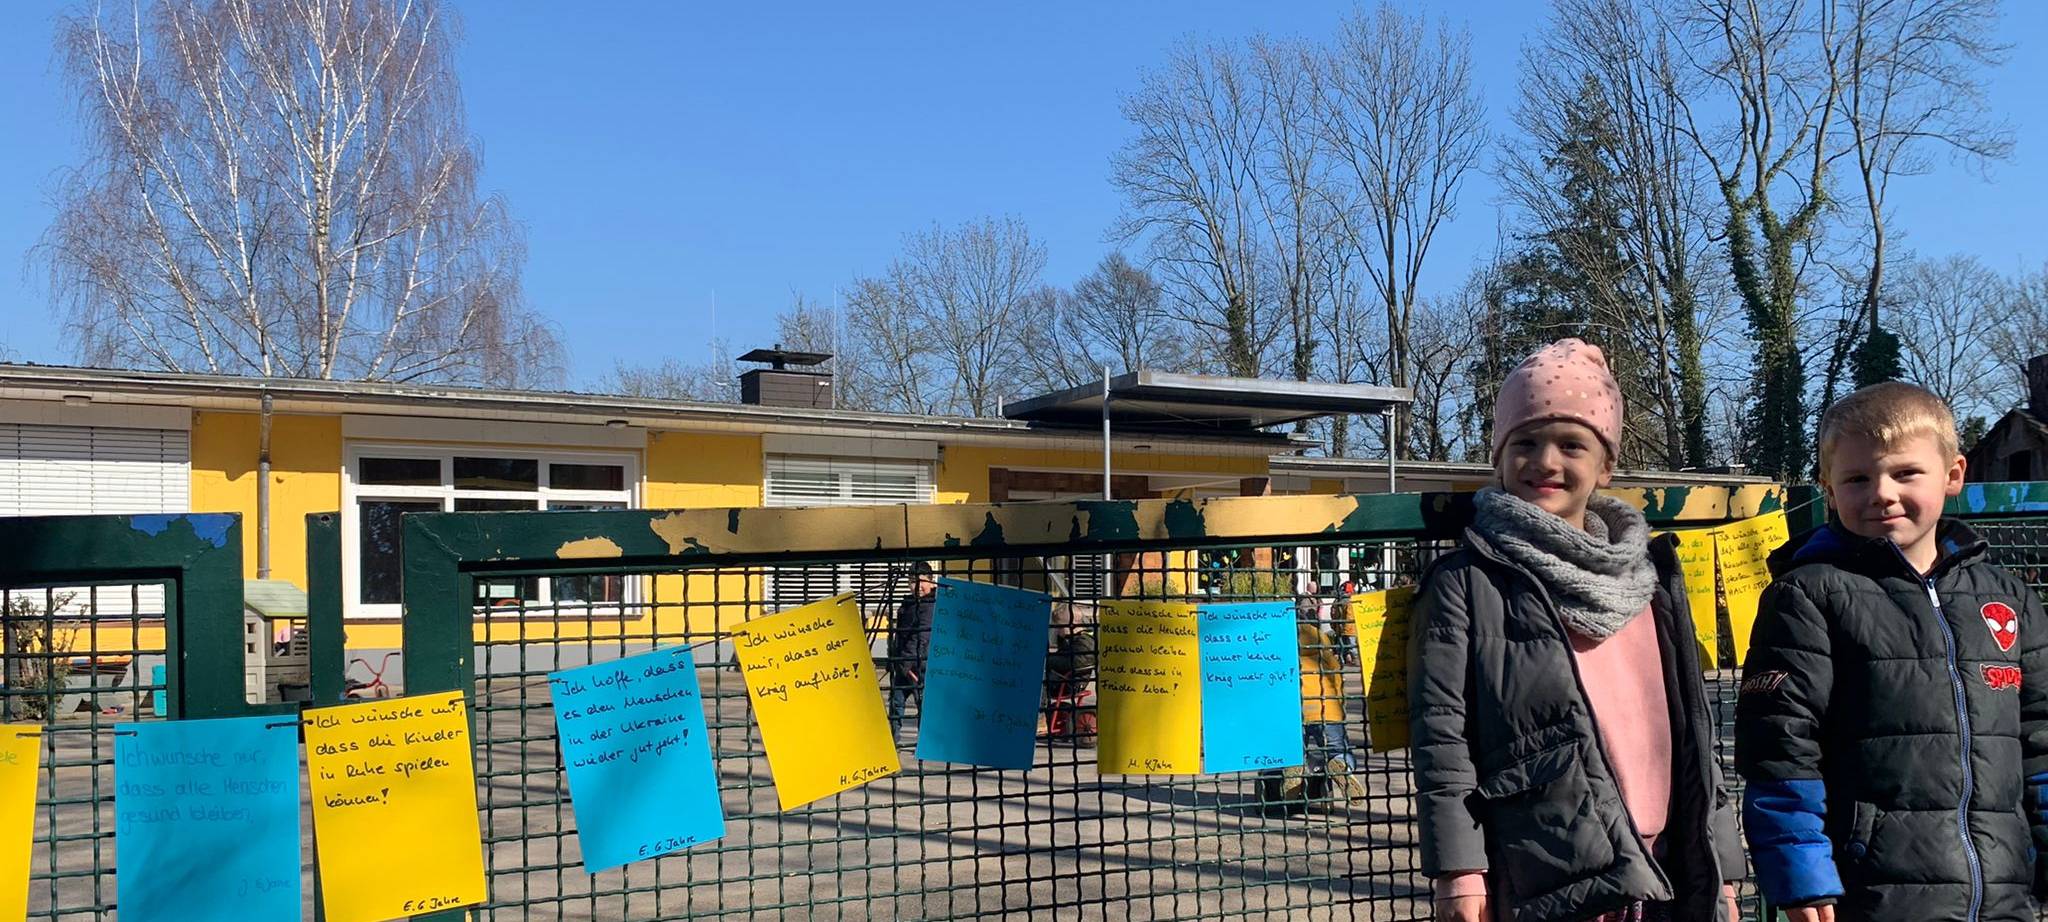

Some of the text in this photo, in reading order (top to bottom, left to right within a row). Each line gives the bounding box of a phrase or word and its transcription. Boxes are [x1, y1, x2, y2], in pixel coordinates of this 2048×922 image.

[1127, 606, 1173, 618] wünsche
[1223, 609, 1268, 620] wünsche
[743, 617, 835, 648] Ich wünsche
[1102, 624, 1196, 636] dass die Menschen
[1203, 631, 1272, 645] dass es für
[784, 647, 819, 663] dass
[826, 638, 849, 652] der
[1102, 645, 1187, 657] gesund bleiben
[1205, 650, 1282, 661] immer keinen
[560, 681, 587, 696] Ich
[643, 660, 685, 677] dass
[1101, 665, 1126, 674] und
[1171, 666, 1182, 677] in
[1238, 672, 1264, 680] mehr
[562, 688, 693, 720] es den Menschen
[316, 715, 341, 729] Ich
[352, 707, 425, 724] wünsche
[568, 712, 686, 745] in der Ukraine
[315, 729, 464, 756] dass die Kinder
[121, 742, 149, 768] Ich
[573, 749, 625, 768] wieder
[630, 740, 653, 764] gut
[320, 758, 450, 780] in Ruhe spielen
[120, 777, 288, 797] dass alle Menschen
[121, 805, 182, 834] gesund
[664, 834, 697, 850] Jahre
[429, 895, 461, 911] Jahre
